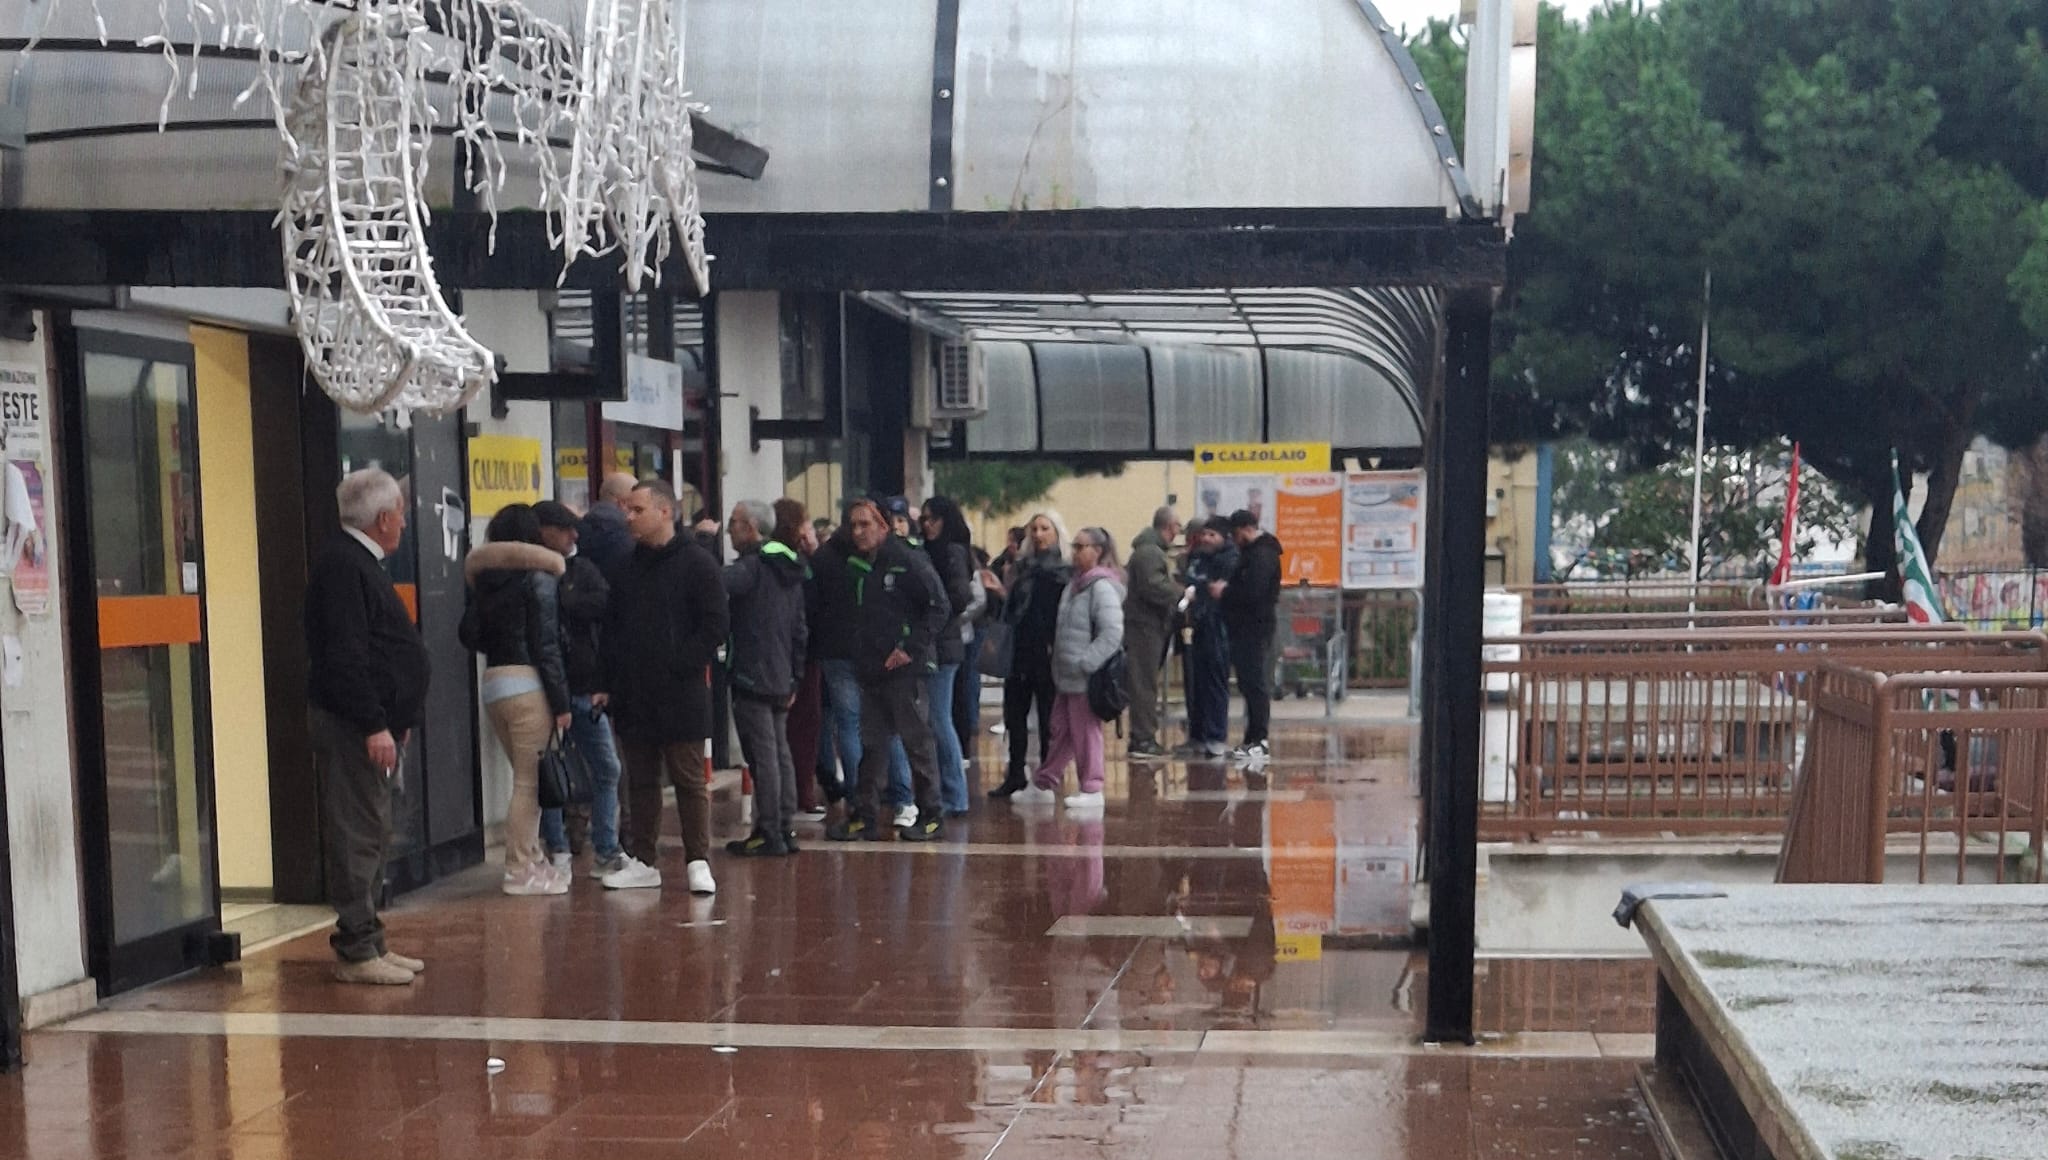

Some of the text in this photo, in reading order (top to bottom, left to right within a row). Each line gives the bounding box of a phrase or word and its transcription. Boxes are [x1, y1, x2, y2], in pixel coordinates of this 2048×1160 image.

[0, 391, 39, 421] ESTE
[1217, 449, 1307, 461] CALZOLAIO
[473, 457, 529, 491] CALZOLAIO
